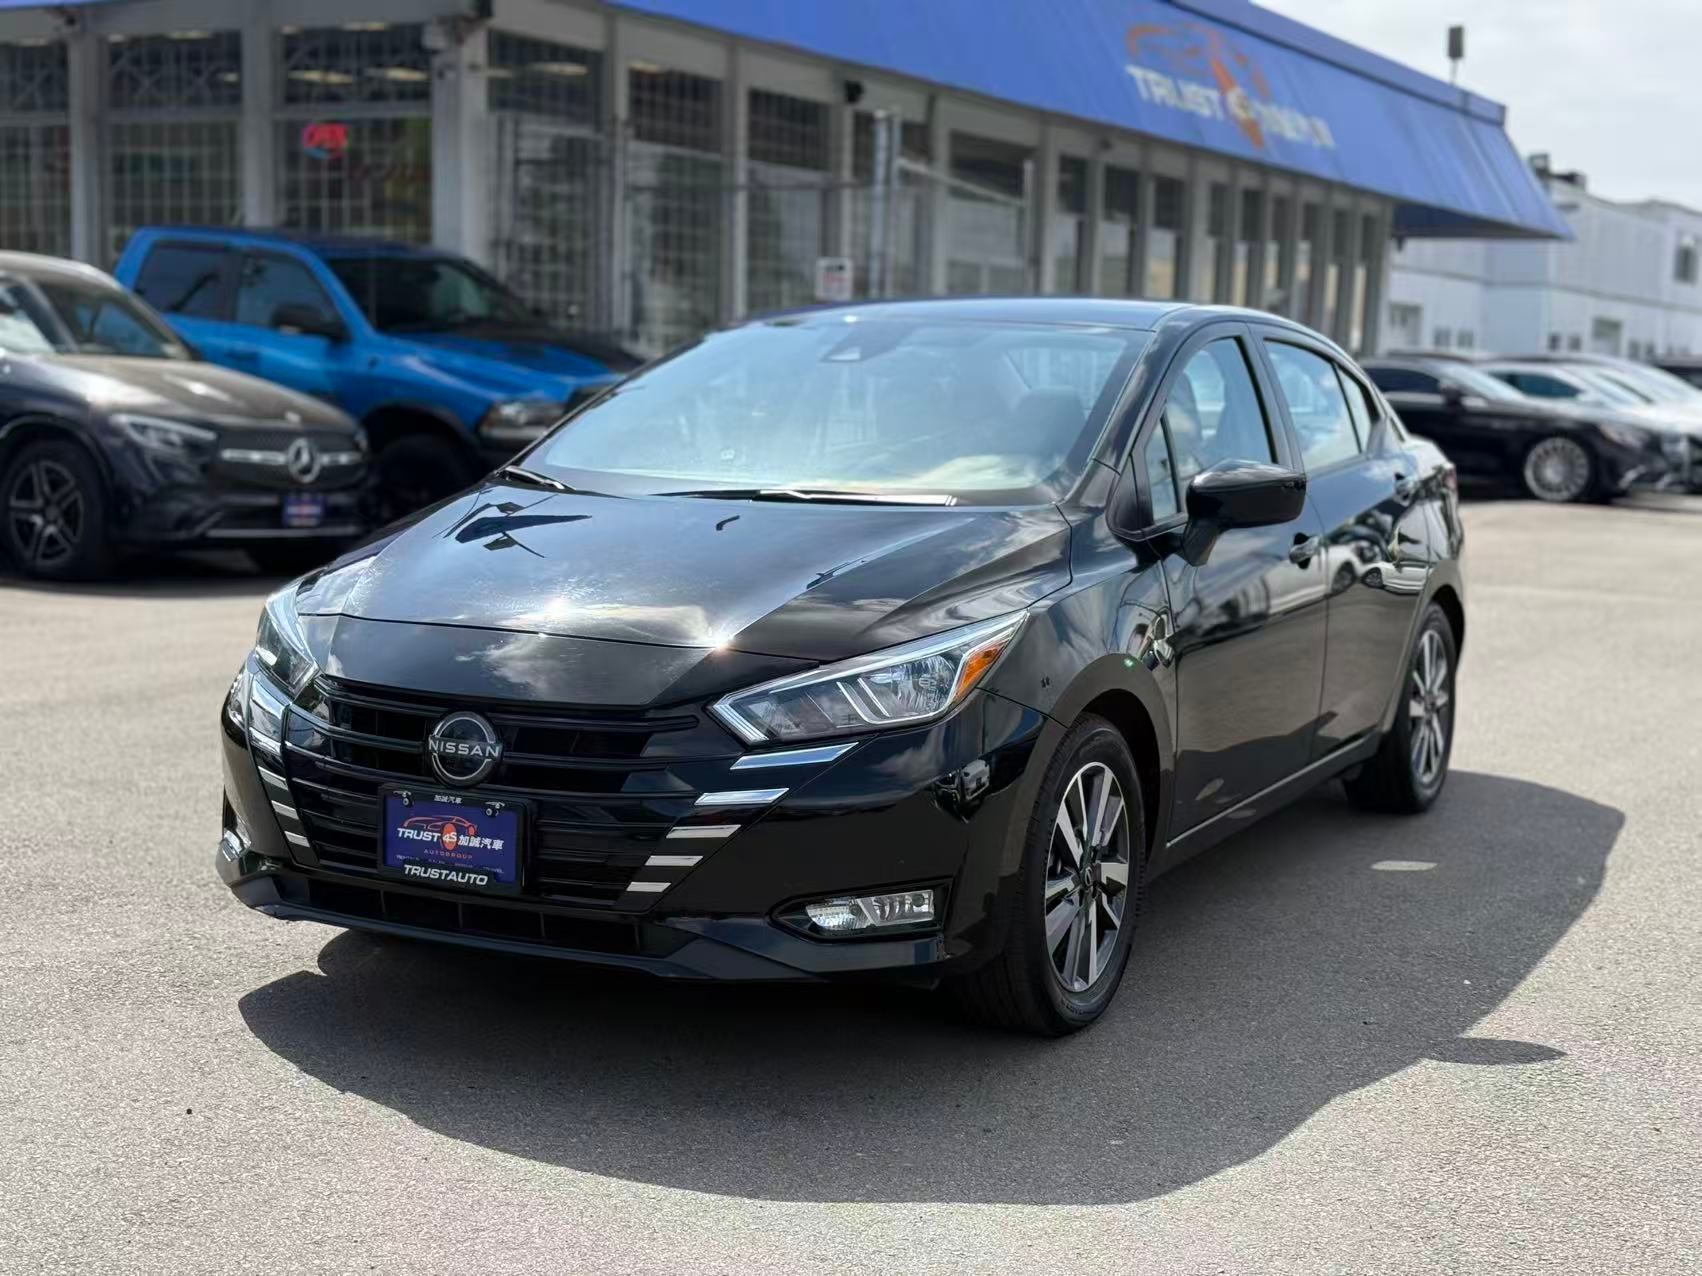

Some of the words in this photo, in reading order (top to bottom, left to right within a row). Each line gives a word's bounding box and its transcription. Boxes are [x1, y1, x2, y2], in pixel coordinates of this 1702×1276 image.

[428, 737, 500, 757] NISSAN
[397, 827, 441, 843] TRUST
[458, 835, 505, 850] 加誠汽車
[403, 864, 488, 886] TRUSTAUTO
